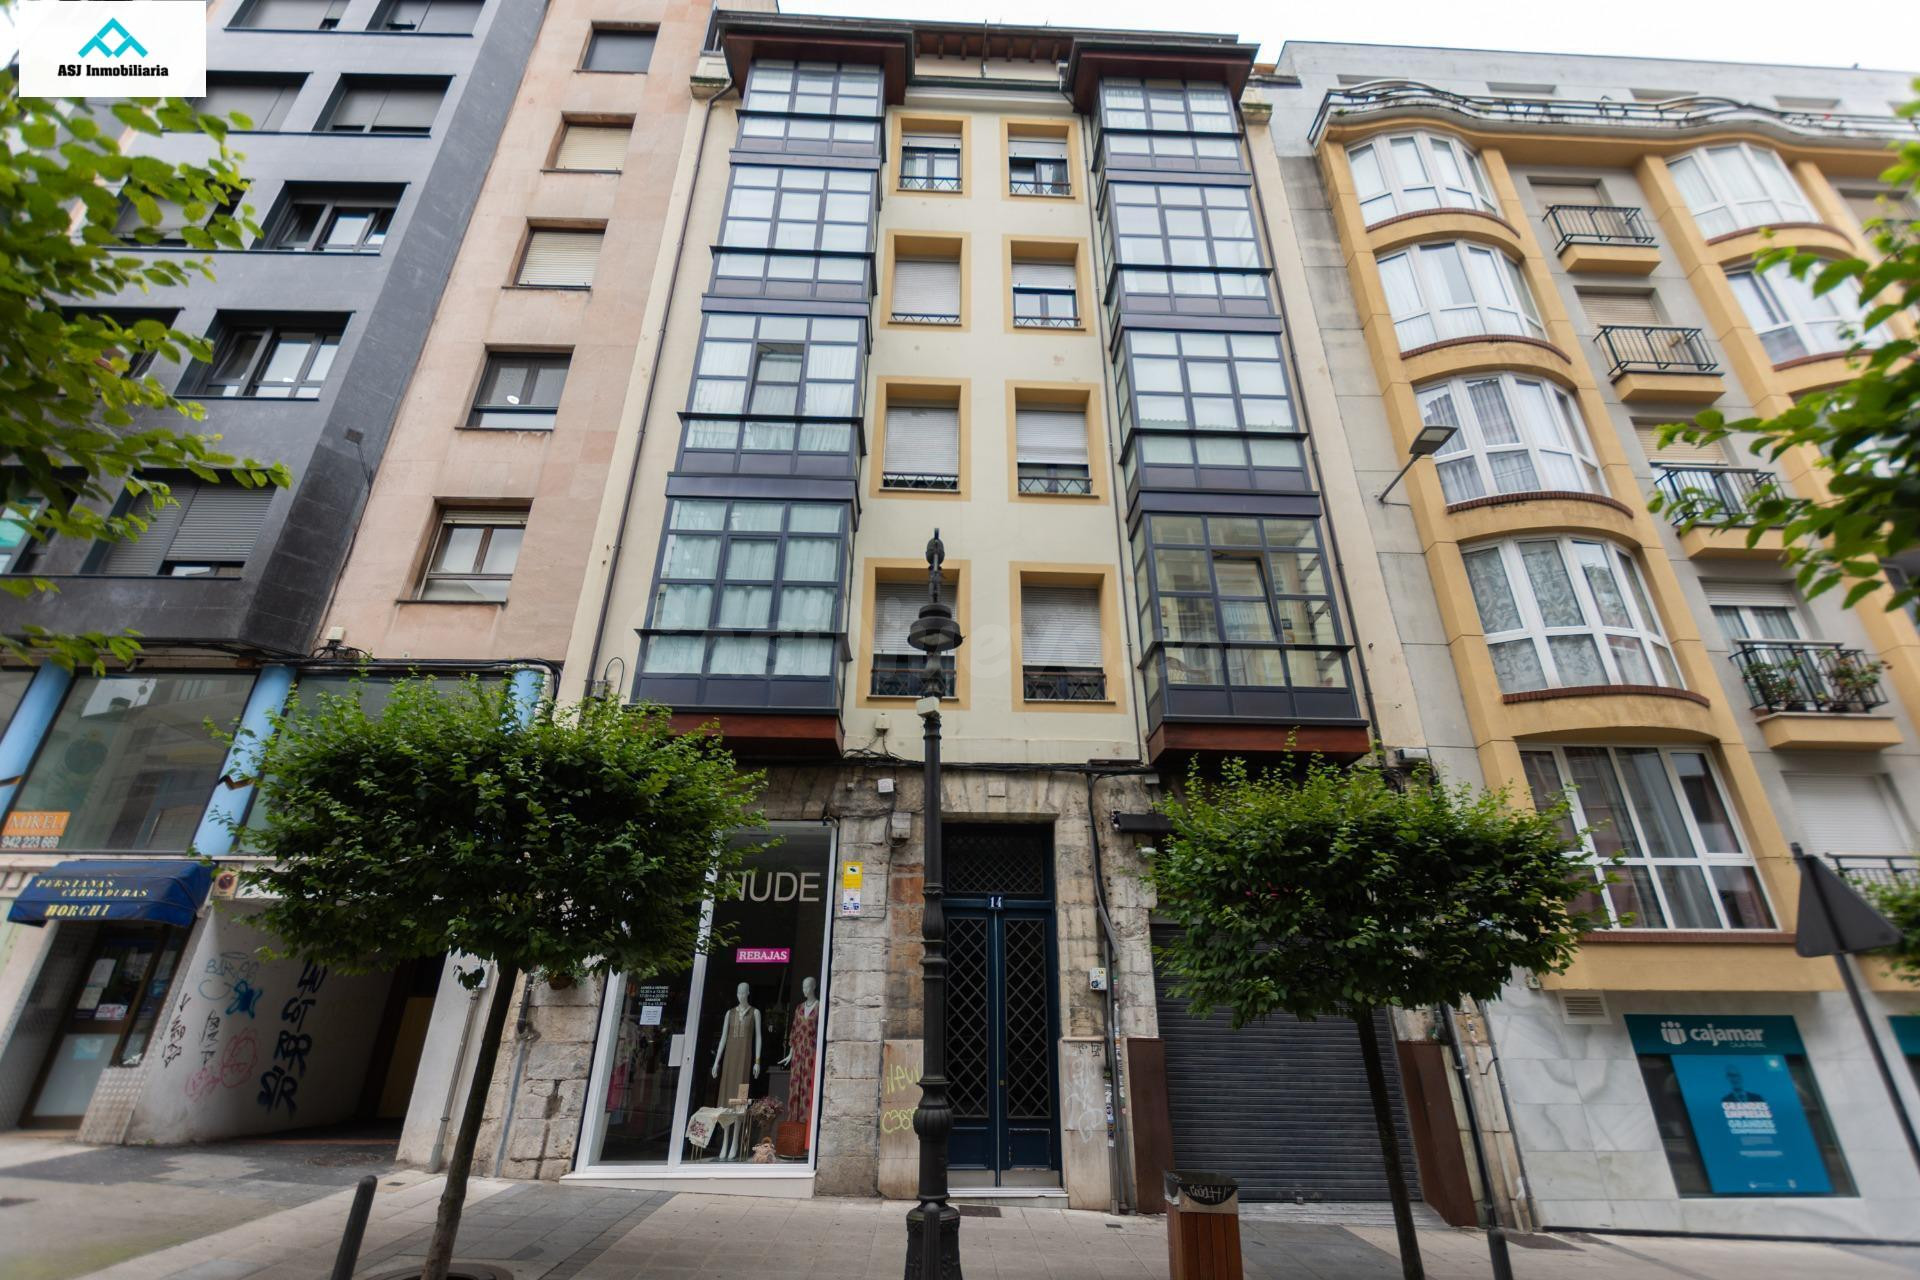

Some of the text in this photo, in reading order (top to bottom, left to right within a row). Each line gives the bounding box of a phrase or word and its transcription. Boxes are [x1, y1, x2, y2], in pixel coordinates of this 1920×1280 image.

[1, 836, 21, 848] 942
[21, 836, 40, 848] 223
[36, 879, 114, 888] PERSIANAS
[61, 889, 149, 898] CERRADURAS
[990, 896, 1002, 908] 14
[738, 951, 788, 961] REBAJAS
[1689, 1023, 1765, 1047] cajamar
